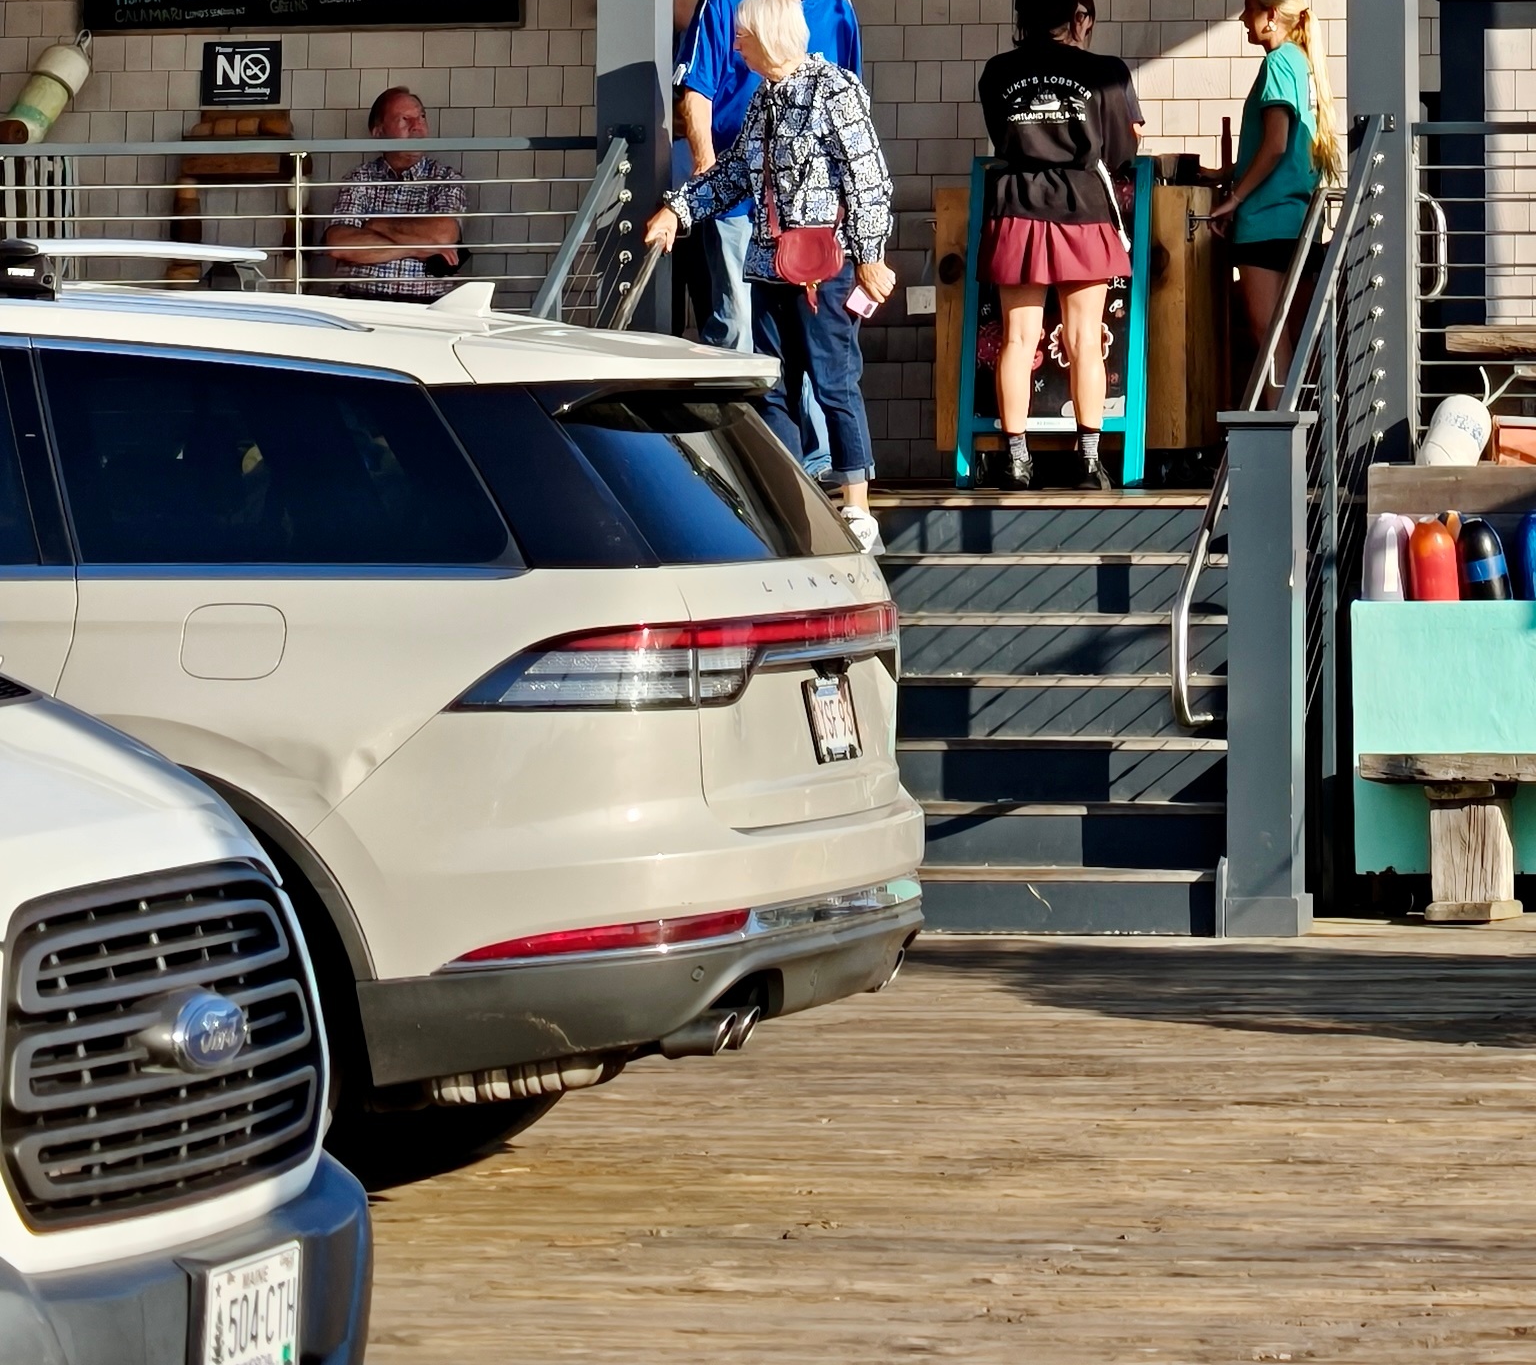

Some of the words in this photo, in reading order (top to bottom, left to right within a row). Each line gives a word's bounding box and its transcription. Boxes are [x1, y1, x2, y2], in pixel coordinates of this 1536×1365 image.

[1002, 75, 1039, 100] LUKE'S
[1043, 75, 1092, 101] LOBSTER
[200, 1010, 238, 1054] Ford
